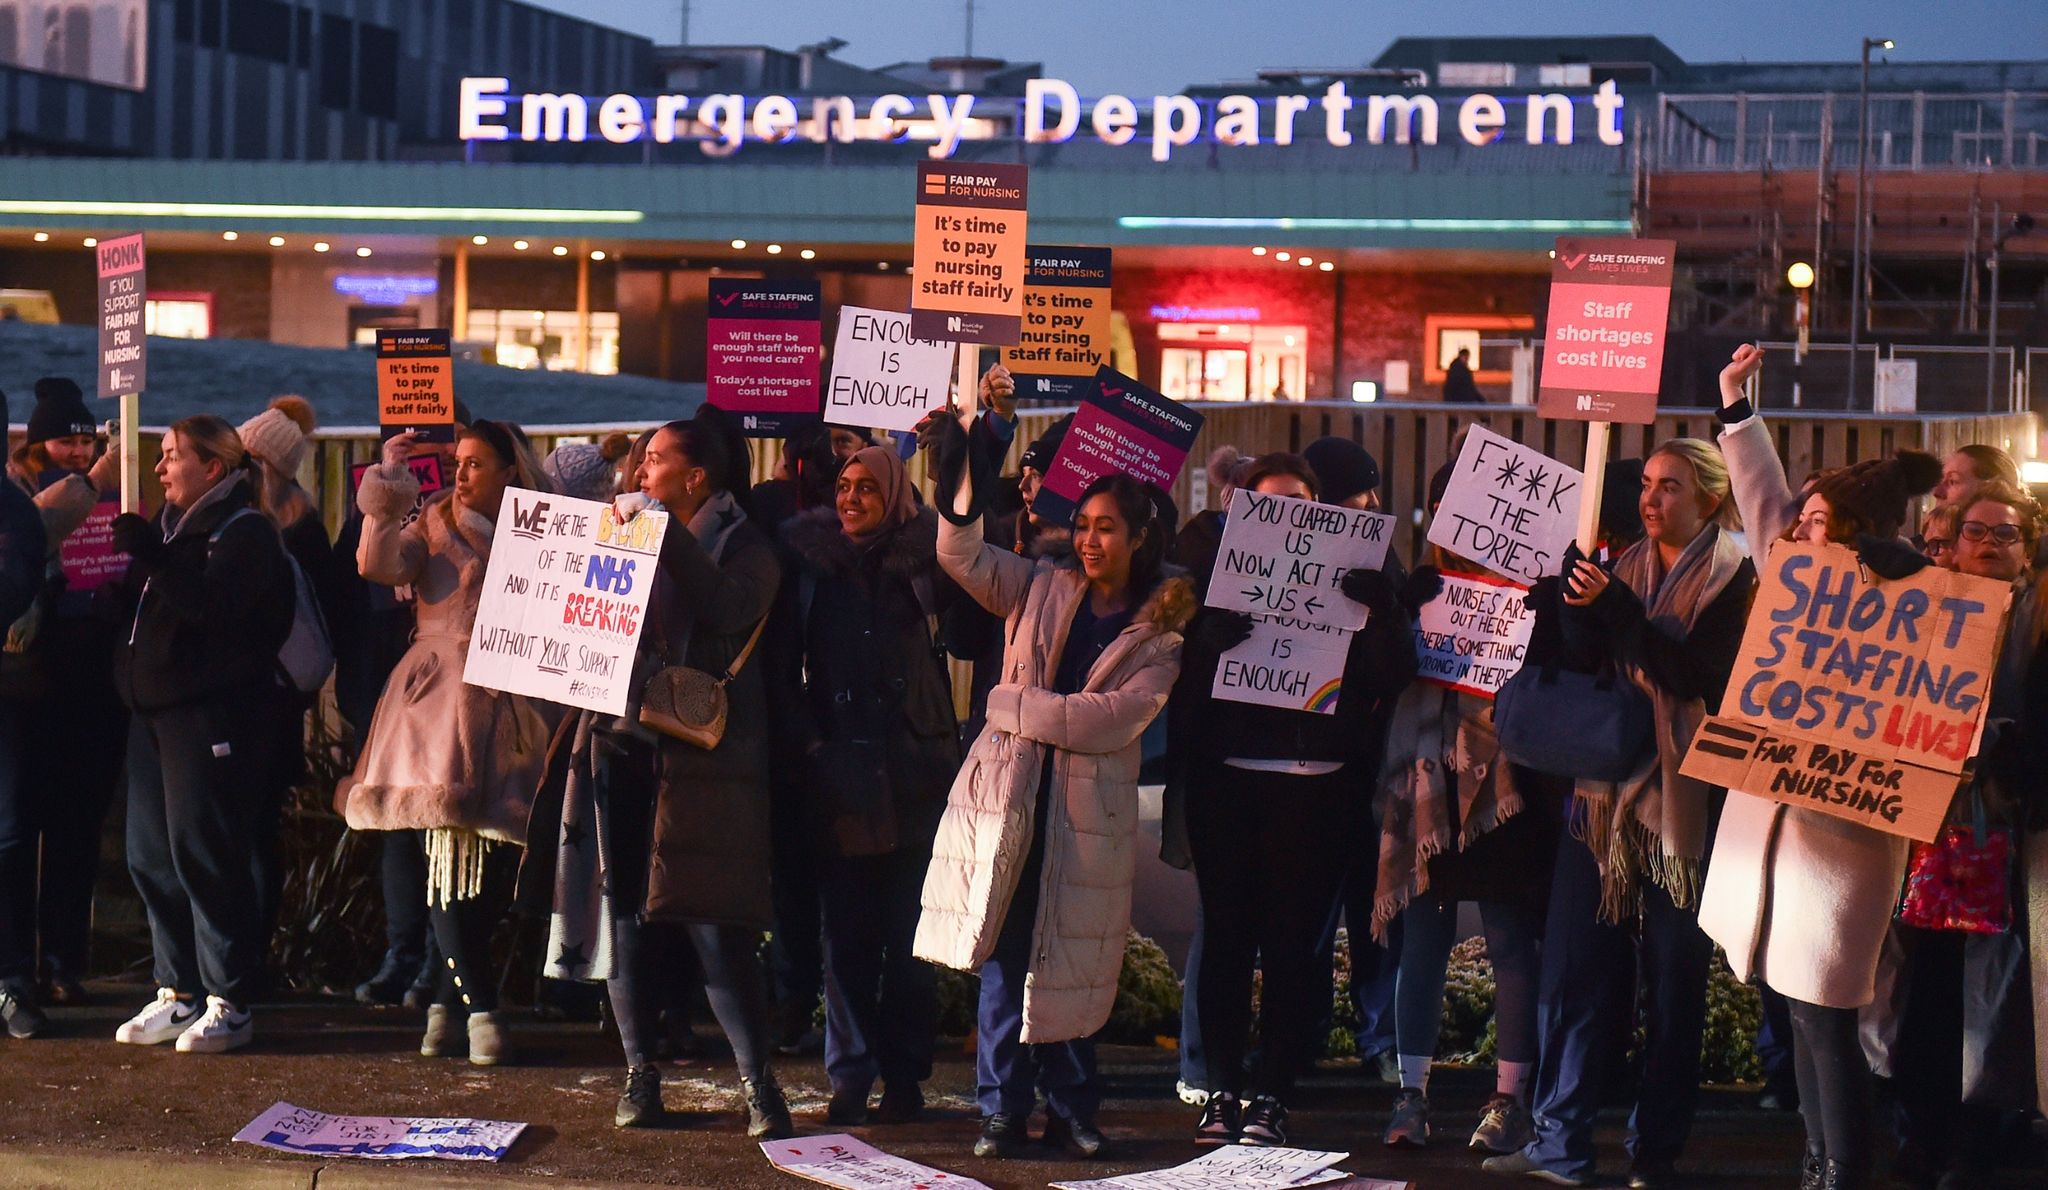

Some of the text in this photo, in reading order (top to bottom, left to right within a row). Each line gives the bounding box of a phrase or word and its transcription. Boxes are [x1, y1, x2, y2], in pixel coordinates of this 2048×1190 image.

[459, 77, 1623, 161] Emergency Department
[949, 175, 997, 187] FAIR PAY
[949, 186, 1020, 199] FOR NURSING
[935, 215, 1007, 234] It's time
[102, 242, 140, 271] HONK
[942, 238, 997, 259] to pay
[935, 259, 1002, 281] nursing
[1034, 259, 1081, 268] FAIR PAY
[1588, 254, 1666, 265] SAFE STAFFING
[1588, 263, 1649, 274] SAVES LIVES
[1034, 268, 1105, 278] FOR NURSING
[109, 277, 134, 295] IF YOU
[922, 280, 1014, 303] staff fairly
[104, 293, 139, 313] SUPPORT
[742, 292, 814, 302] SAFE STAFFING
[1024, 293, 1093, 309] t's time
[105, 310, 139, 330] FAIR PAY
[1027, 312, 1084, 329] to pay
[1583, 301, 1633, 319] Staff
[114, 330, 130, 346] FOR
[729, 331, 799, 342] Will there be
[1020, 329, 1090, 348] nursing
[1556, 324, 1654, 348] shortages
[105, 345, 140, 365] NURSING
[713, 343, 815, 354] enough staff when
[1009, 347, 1102, 366] staff fairly
[390, 363, 440, 375] It's time
[722, 354, 804, 365] you need care?
[880, 351, 900, 373] IS
[1556, 350, 1647, 369] cost lives
[396, 378, 435, 390] to pay
[714, 375, 812, 388] Today's shortages
[737, 387, 789, 397] cost lives
[392, 390, 440, 403] nursing
[832, 376, 928, 409] ENOUGH
[386, 403, 449, 416] staff fairly
[1123, 392, 1149, 410] SAFE
[1148, 404, 1193, 432] STAFFING
[1074, 426, 1171, 481] enough staff when
[1095, 423, 1161, 463] Will there be
[1078, 441, 1158, 484] you need care?
[514, 497, 551, 534] WE
[548, 512, 571, 537] ARE
[570, 515, 589, 538] THE
[1242, 491, 1385, 542] YOU CLAPPED FOR
[1487, 494, 1540, 536] THE
[1285, 530, 1314, 556] US
[1452, 513, 1551, 580] TORIES
[63, 556, 96, 568] oday's
[1225, 548, 1276, 579] NOW
[1287, 559, 1326, 587] ACT
[538, 550, 636, 596] OF THE NHS
[504, 574, 561, 601] AND IT IS
[1267, 585, 1299, 612] US
[1445, 585, 1527, 620] NURSES ARE
[1770, 555, 1985, 649] SHORT
[563, 592, 640, 637] BREAKING
[1450, 611, 1515, 637] OUT HERE
[480, 624, 619, 680] WITHOUT YOUR SUPPORT
[1271, 638, 1293, 659] IS
[1455, 637, 1526, 663] SOMETHING
[1223, 659, 1311, 697] ENOUGH
[1456, 662, 1470, 679] IN
[1755, 625, 1981, 715] STAFFING
[1740, 670, 1980, 762] COSTS LIVES
[1753, 736, 1904, 791] FAIR PAY FOR
[1770, 767, 1904, 824] NURSING
